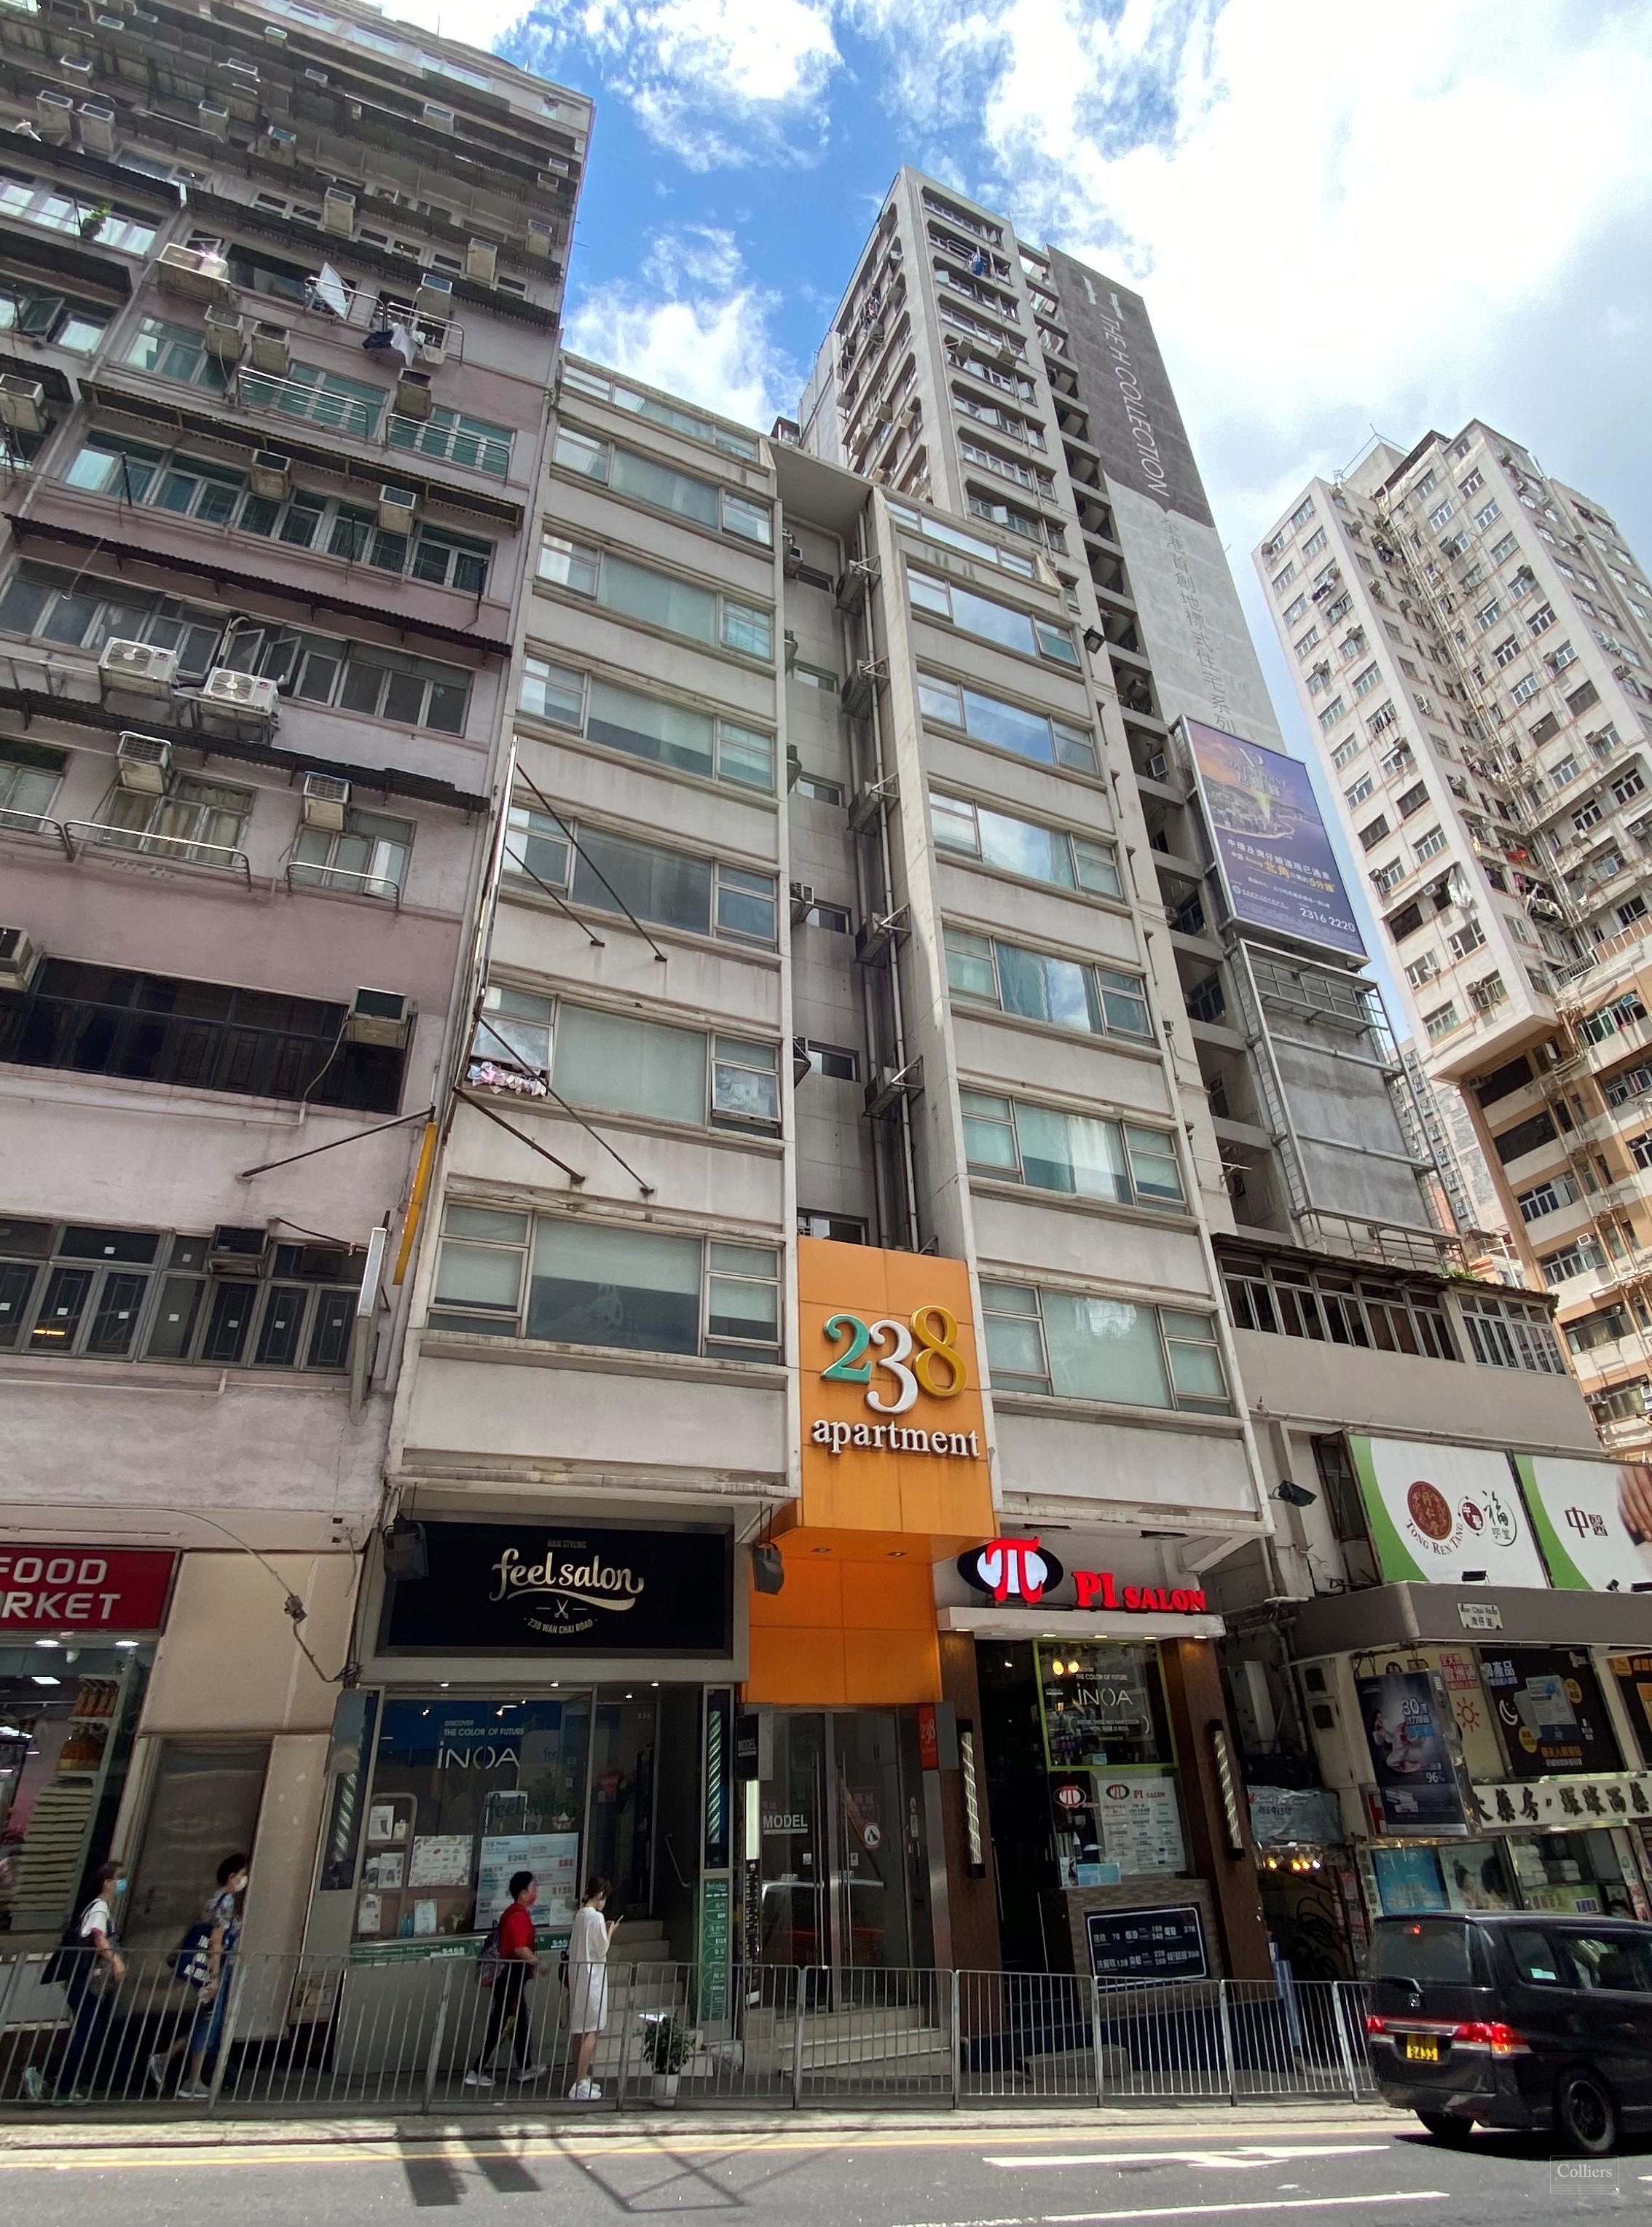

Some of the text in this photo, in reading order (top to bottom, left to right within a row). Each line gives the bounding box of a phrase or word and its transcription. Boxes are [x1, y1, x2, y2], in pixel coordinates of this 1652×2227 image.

[1099, 313, 1171, 498] THE H COLLECTION
[1299, 907, 1356, 933] 2316 2220
[820, 1304, 968, 1415] 238
[811, 1418, 981, 1458] apartment
[1564, 1506, 1608, 1539] 中醫
[489, 1547, 645, 1602] feel salon
[1072, 1571, 1207, 1612] PI SALON
[542, 1623, 558, 1634] WAN
[559, 1625, 575, 1634] CHAI
[575, 1619, 594, 1633] ROAD
[444, 1727, 525, 1737] THE COLOR OF FUTURE
[920, 1718, 937, 1745] 238
[1133, 1790, 1144, 1799] PI
[763, 1814, 809, 1829] MODEL
